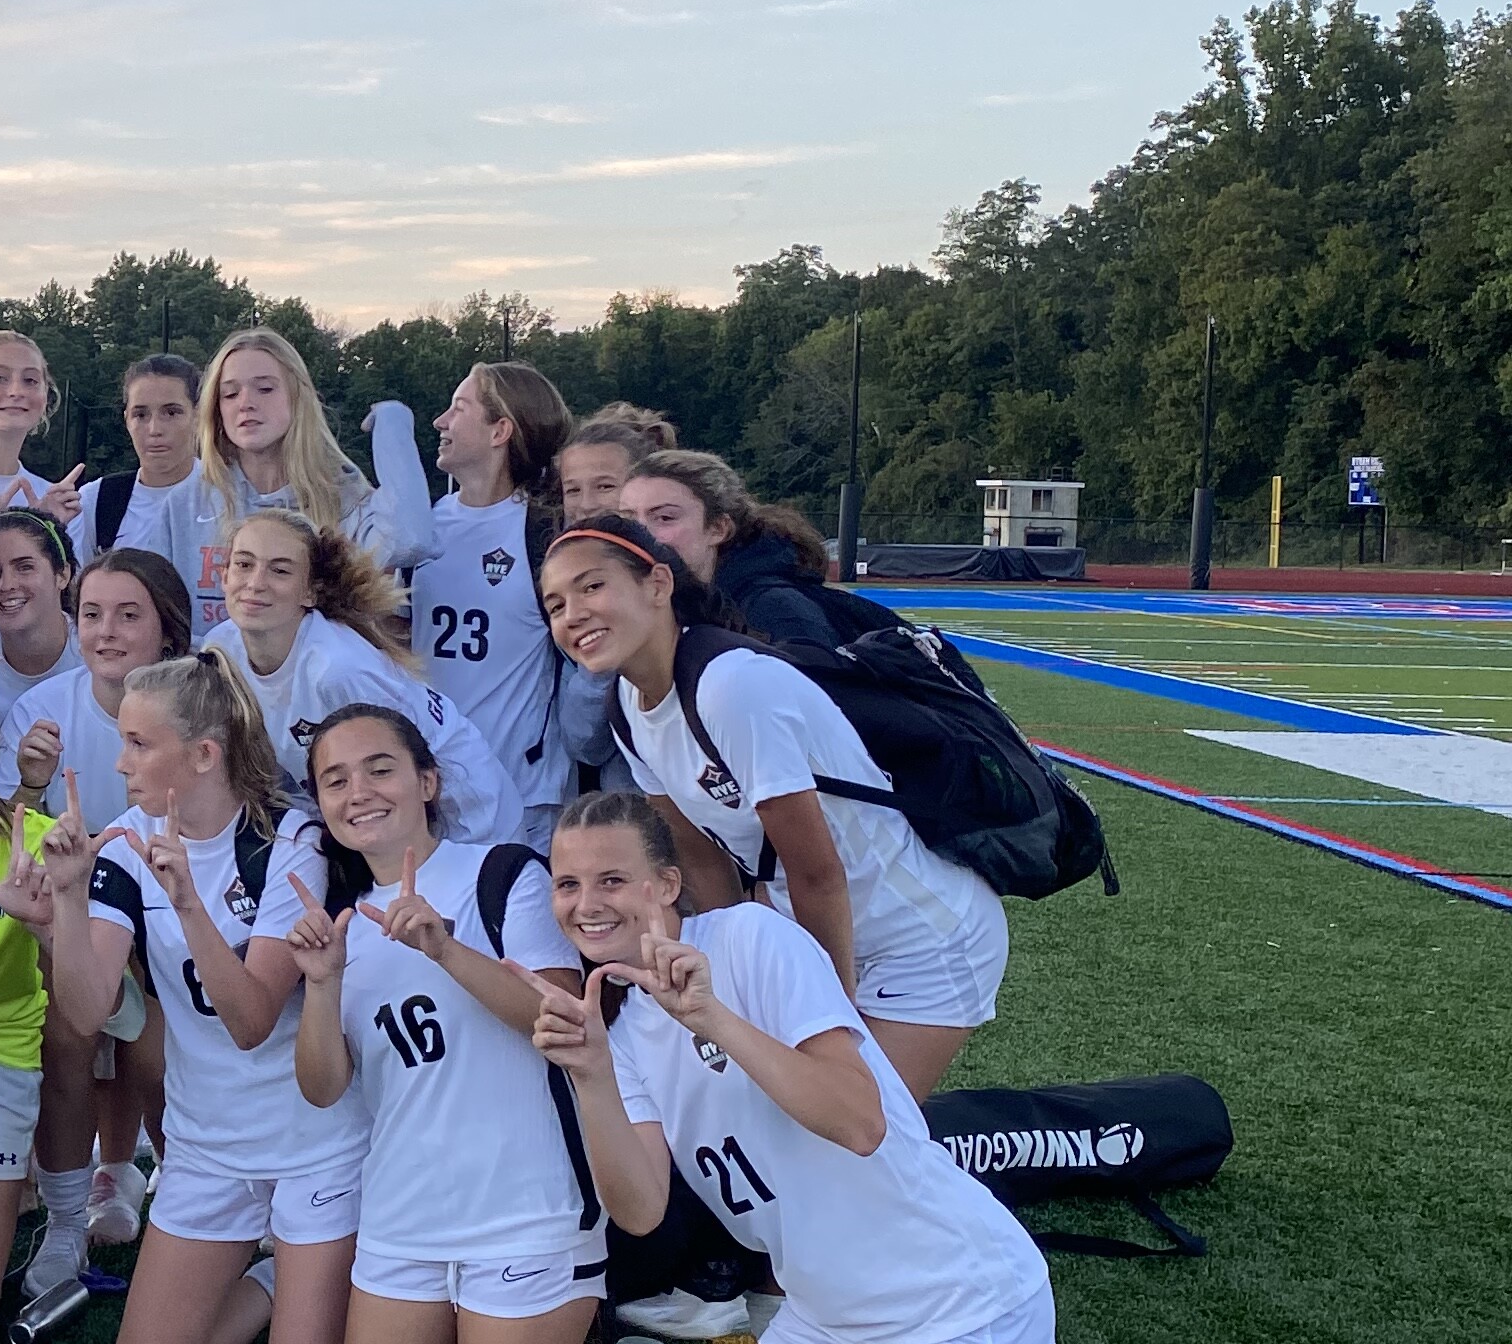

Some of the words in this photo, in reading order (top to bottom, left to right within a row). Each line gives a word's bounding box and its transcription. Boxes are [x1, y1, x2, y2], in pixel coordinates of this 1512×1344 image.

[485, 562, 509, 575] RYE
[431, 605, 490, 663] 23
[709, 780, 739, 798] RYE
[374, 994, 446, 1069] 16
[699, 1041, 724, 1059] RY
[695, 1135, 778, 1216] 21
